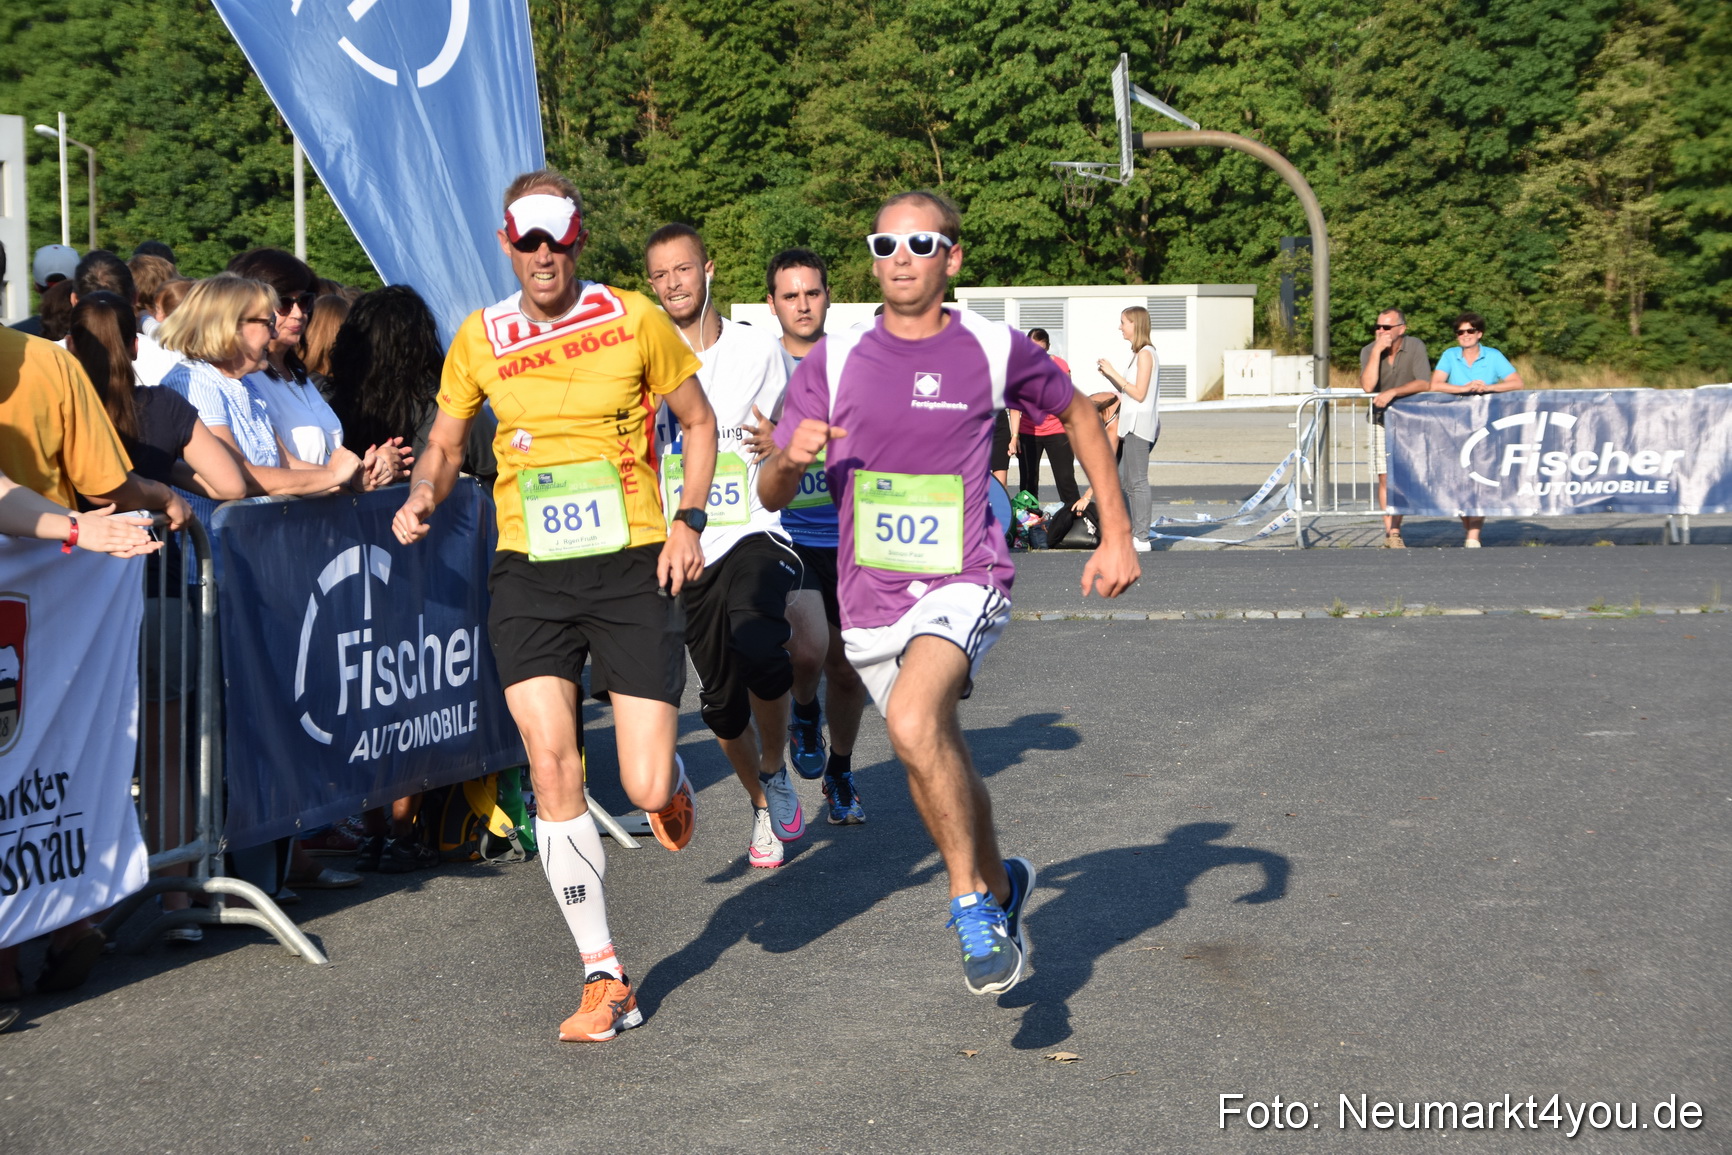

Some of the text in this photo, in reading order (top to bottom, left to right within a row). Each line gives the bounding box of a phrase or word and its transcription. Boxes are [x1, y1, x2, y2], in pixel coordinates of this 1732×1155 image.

[497, 325, 635, 381] MAX BÖGL
[1500, 441, 1686, 477] Fischer
[673, 481, 741, 507] 165
[1517, 479, 1670, 497] AUTOMOBILE
[542, 499, 601, 534] 881
[875, 512, 939, 545] 502
[347, 700, 478, 764] AUTOMOBILE
[566, 896, 586, 906] cep
